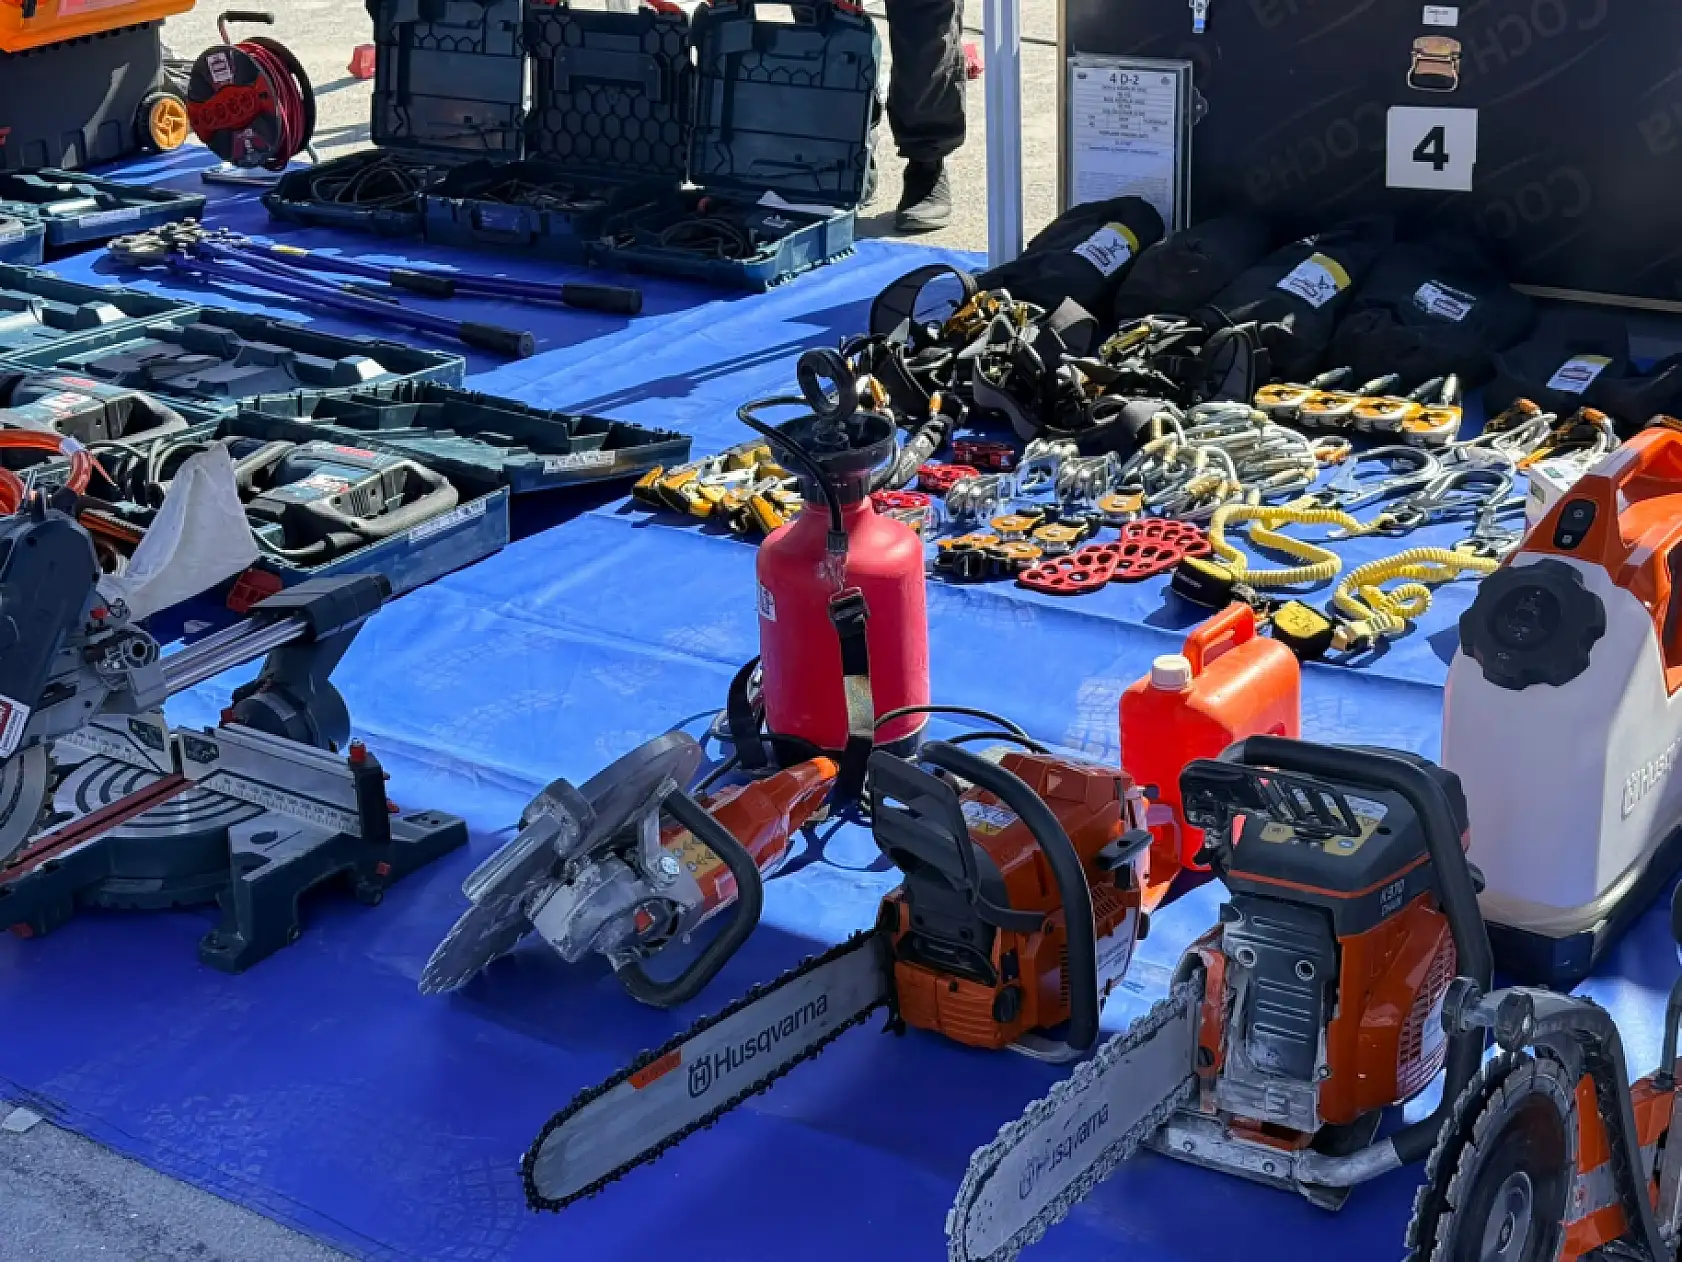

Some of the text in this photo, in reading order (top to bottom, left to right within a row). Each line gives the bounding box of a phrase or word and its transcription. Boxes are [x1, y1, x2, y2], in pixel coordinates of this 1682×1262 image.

[1109, 72, 1117, 84] 4
[1412, 125, 1449, 171] 4
[714, 994, 829, 1080] Husqvarna
